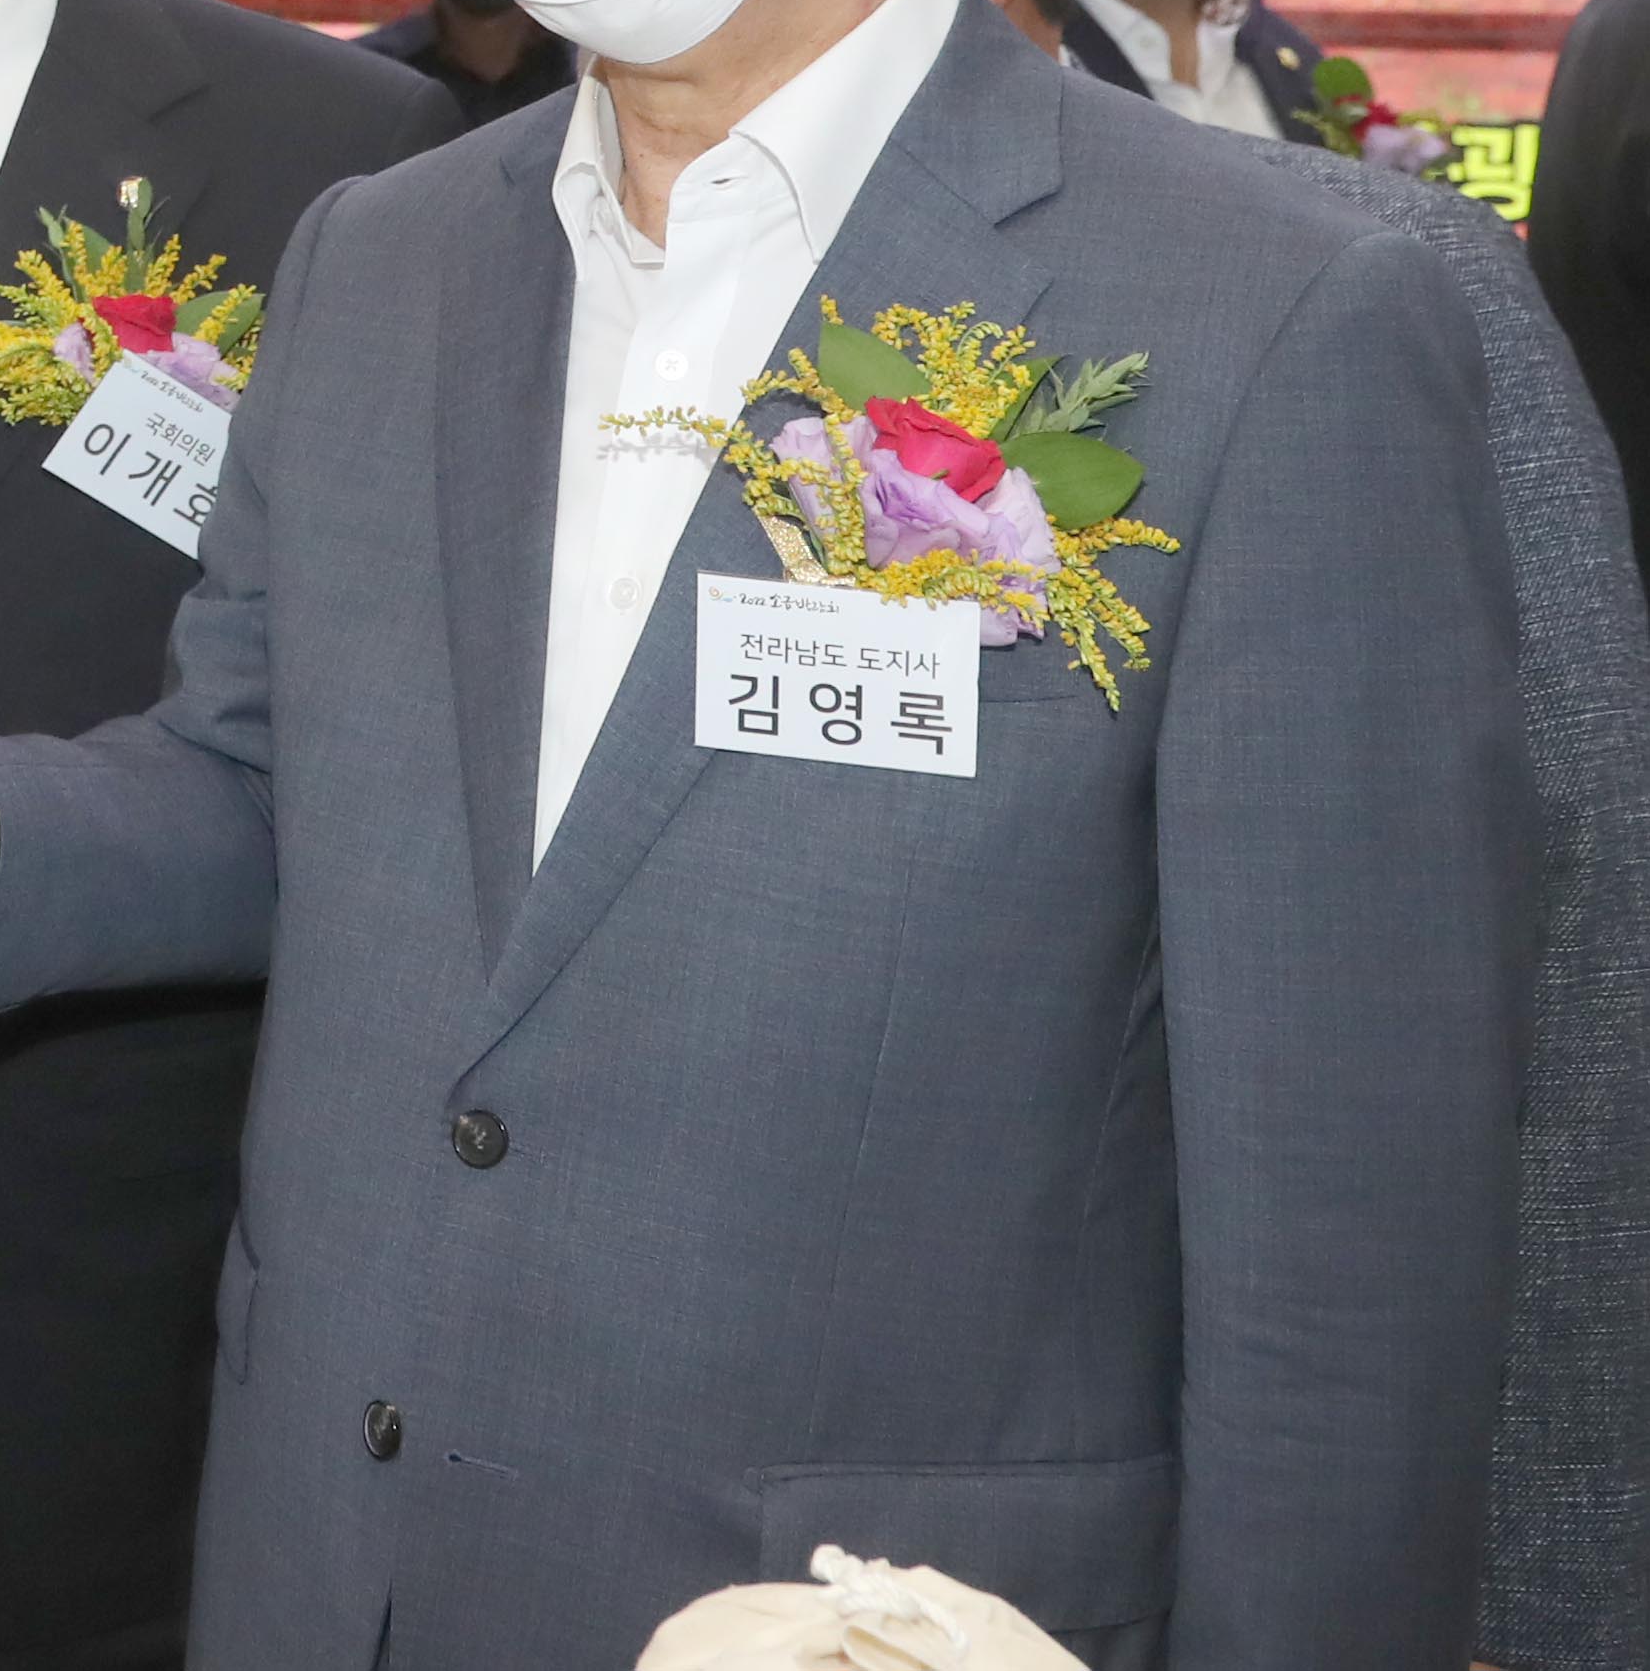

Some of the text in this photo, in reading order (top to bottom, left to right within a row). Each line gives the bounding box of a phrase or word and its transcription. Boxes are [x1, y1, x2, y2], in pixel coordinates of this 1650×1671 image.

[145, 412, 216, 467] 국회의원
[738, 592, 766, 607] 2022
[739, 633, 941, 680] 전라남도 도지사
[727, 673, 953, 756] 김영록
